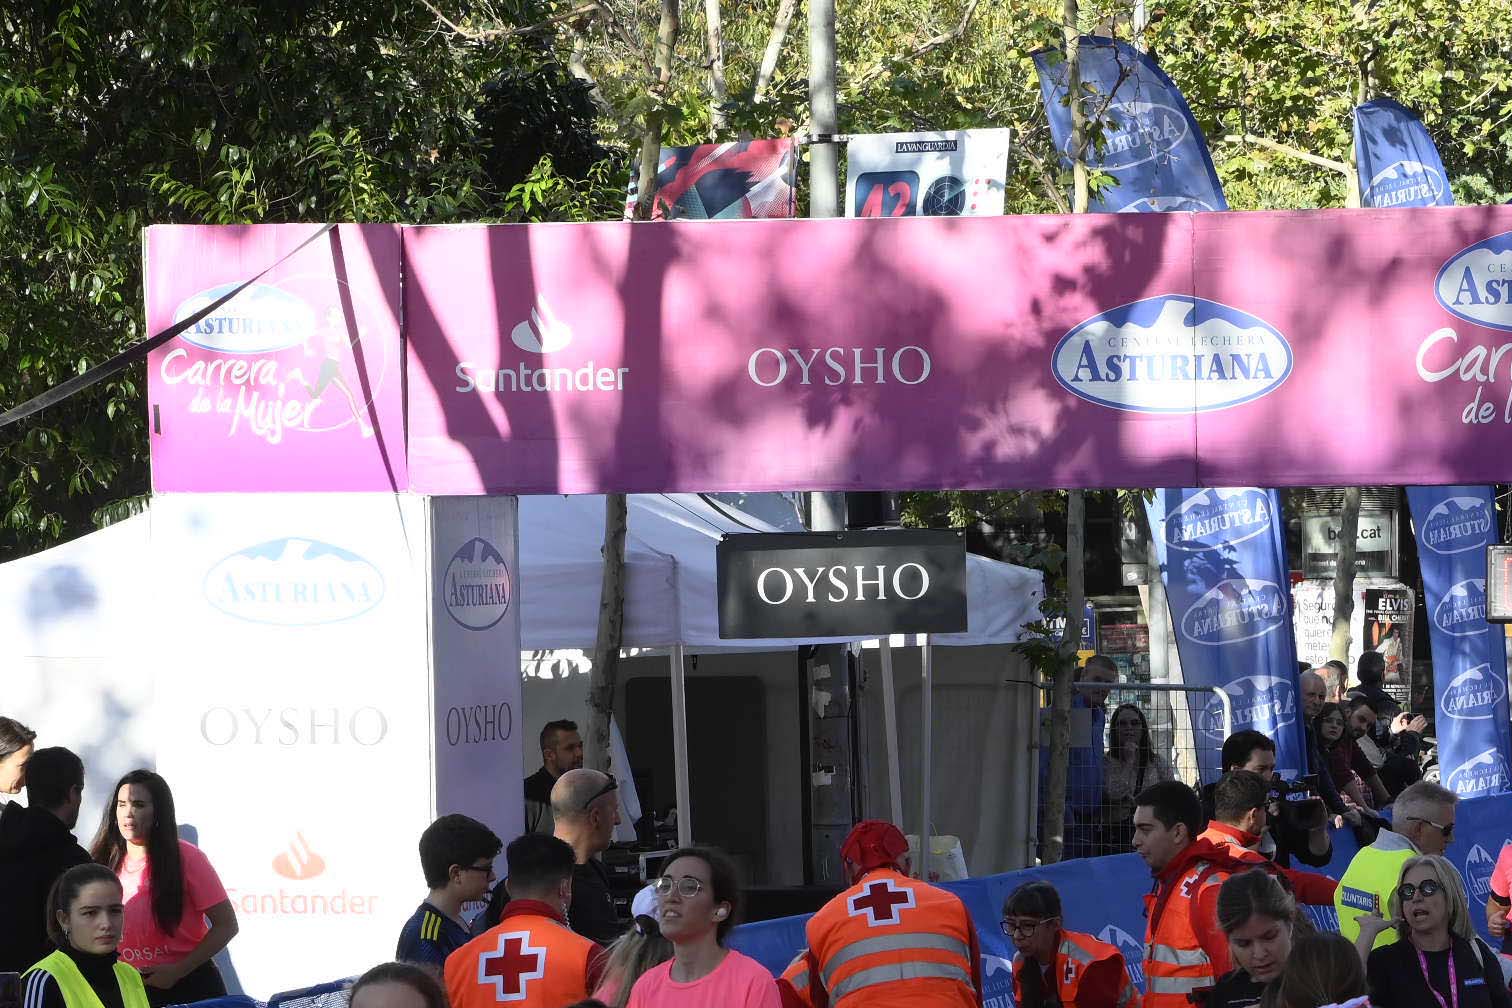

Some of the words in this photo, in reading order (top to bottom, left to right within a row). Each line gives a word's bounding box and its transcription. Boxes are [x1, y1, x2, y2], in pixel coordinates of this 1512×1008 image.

[1107, 336, 1184, 348] CENTRAL
[1191, 334, 1267, 346] LECHERA
[160, 348, 279, 386] Carrera
[455, 360, 629, 393] Santander
[748, 345, 932, 387] OYSHO
[1071, 343, 1274, 384] ASTURIANA
[229, 384, 322, 445] Mujer
[1462, 387, 1496, 425] de
[220, 571, 373, 603] ASTURIANA
[449, 575, 507, 607] ASTURIANA
[757, 562, 930, 605] OYSHO
[1378, 598, 1409, 611] ELVIS
[200, 706, 390, 746] OYSHO
[447, 702, 512, 747] OYSHO
